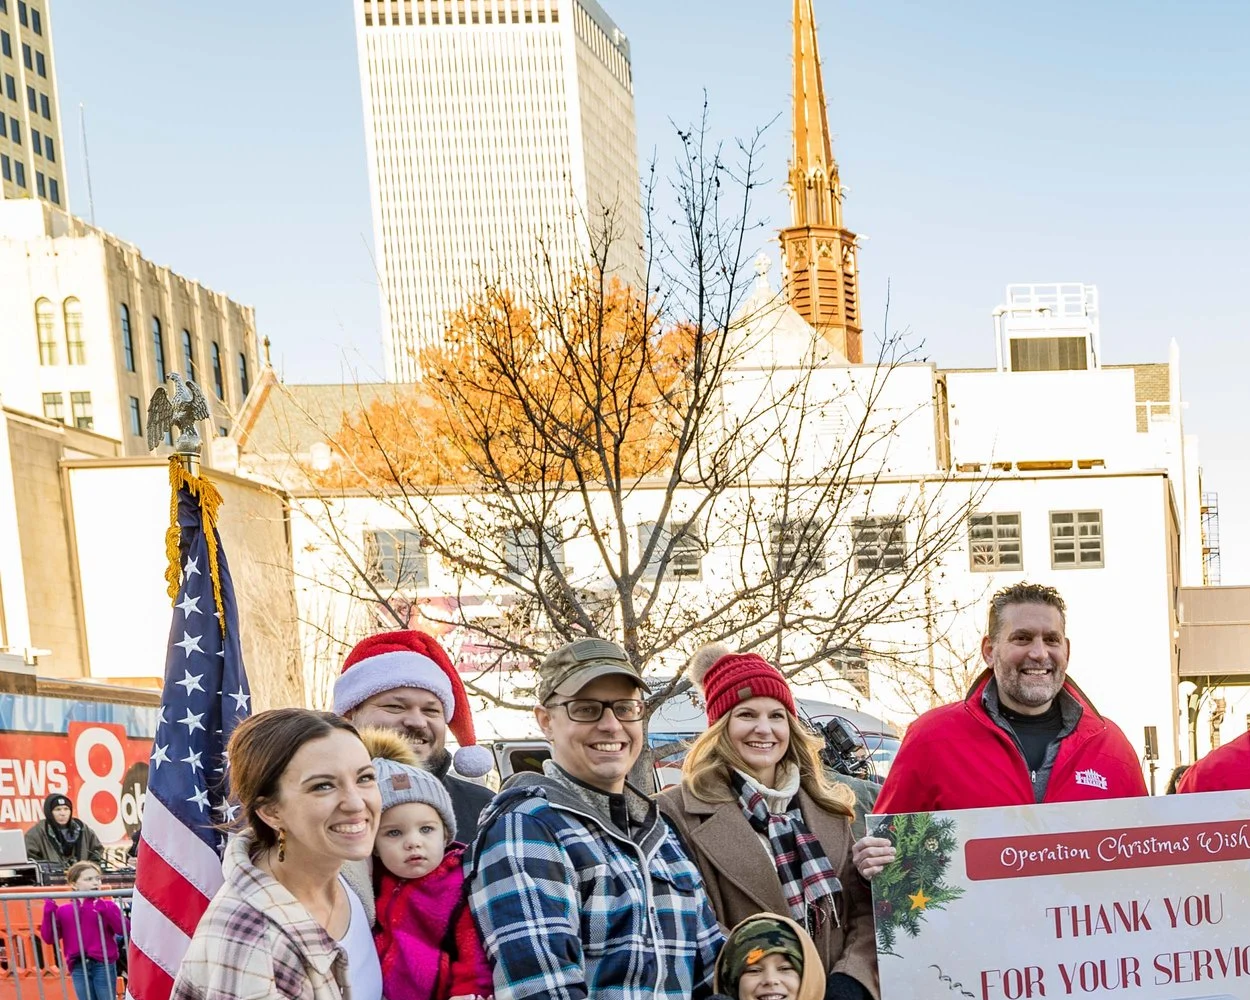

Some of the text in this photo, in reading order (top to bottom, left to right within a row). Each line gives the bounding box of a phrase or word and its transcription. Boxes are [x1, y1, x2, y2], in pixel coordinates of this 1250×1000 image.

[75, 727, 126, 844] 8
[1000, 843, 1090, 871] Operation
[1097, 833, 1190, 862] Christmas
[1045, 893, 1224, 939] THANK YOU
[1058, 957, 1142, 995] YOUR
